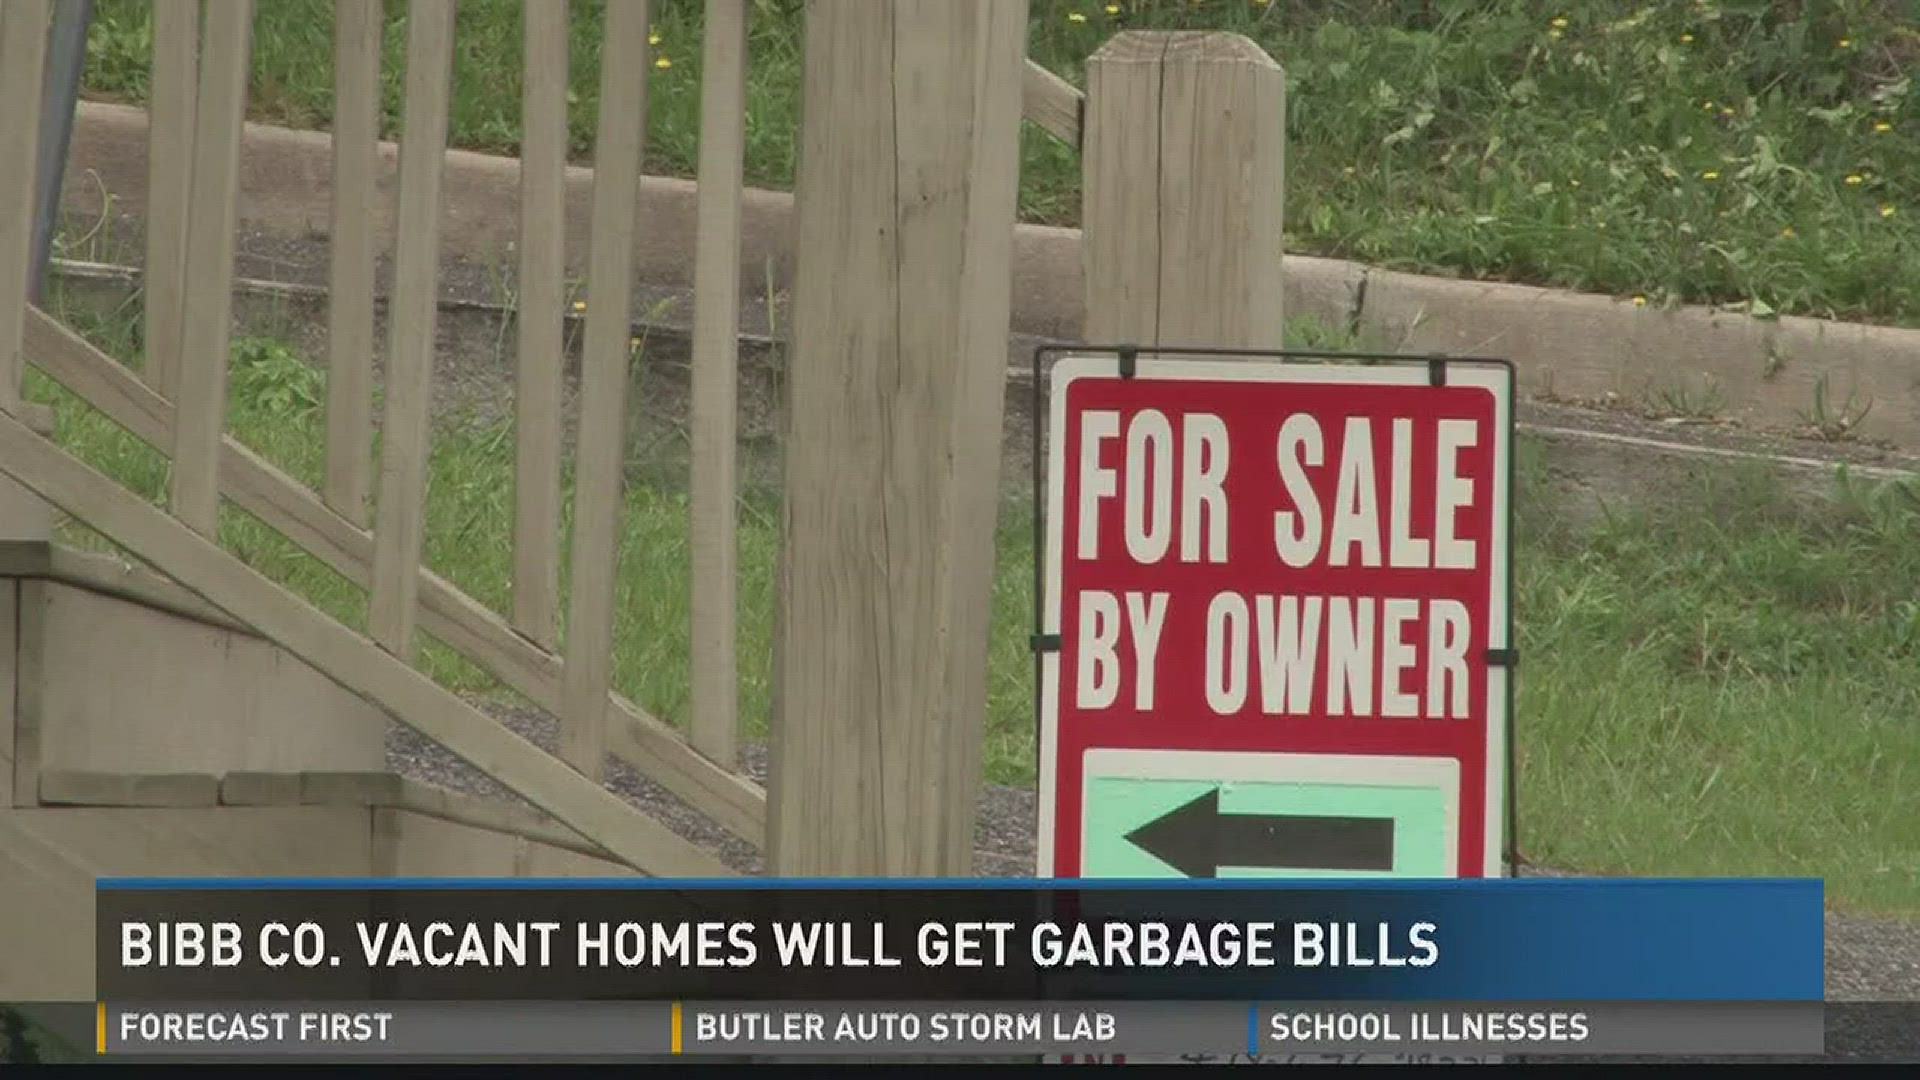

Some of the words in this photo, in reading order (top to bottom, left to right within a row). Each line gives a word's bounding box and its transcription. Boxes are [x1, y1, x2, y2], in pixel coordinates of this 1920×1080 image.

[1077, 409, 1230, 564] FOR
[1273, 412, 1479, 570] SALE
[1075, 589, 1170, 711] BY
[1205, 591, 1472, 719] OWNER
